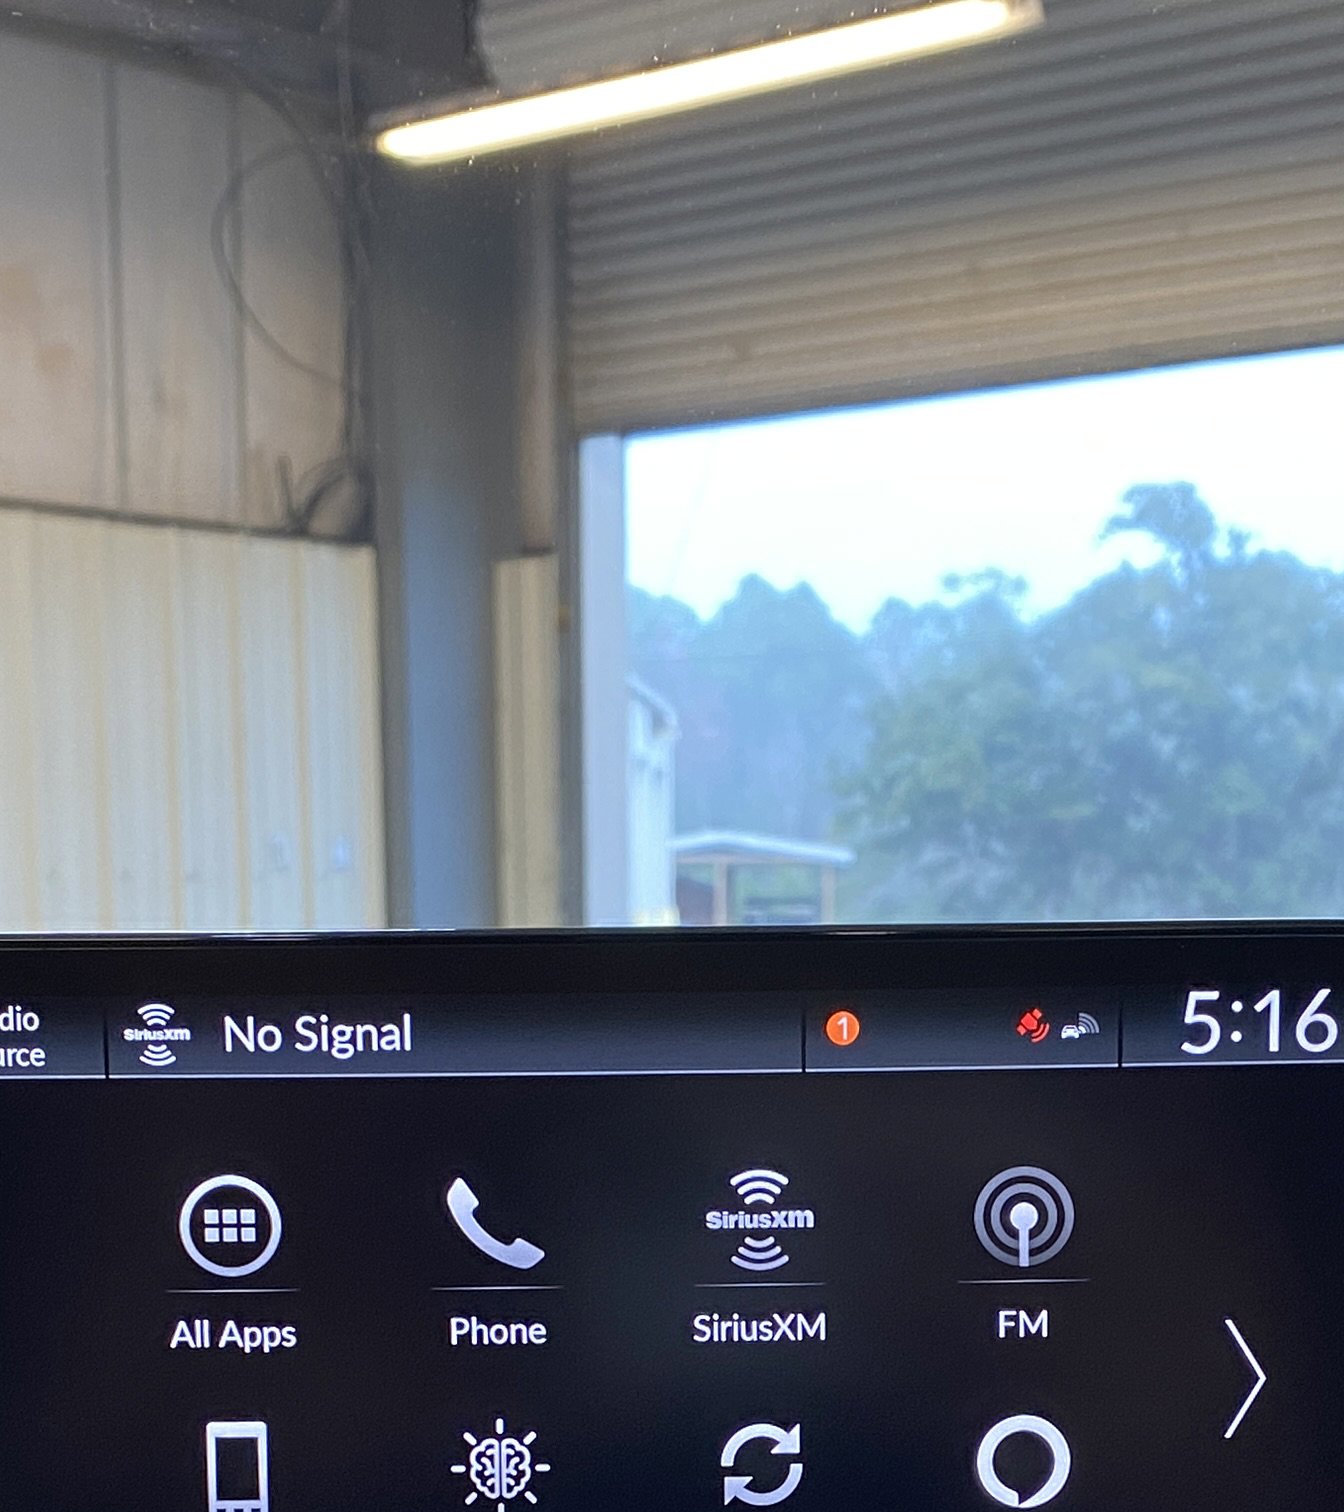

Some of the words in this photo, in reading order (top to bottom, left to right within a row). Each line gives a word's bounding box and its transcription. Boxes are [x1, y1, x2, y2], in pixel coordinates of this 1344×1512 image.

[835, 1016, 850, 1042] 1
[1181, 989, 1338, 1054] 5:16
[224, 1016, 282, 1052] No
[295, 1014, 411, 1059] Signal
[170, 1320, 210, 1348] All
[219, 1320, 296, 1353] Apps
[451, 1316, 547, 1345] Phone
[694, 1313, 825, 1342] SiriusXM
[999, 1310, 1048, 1338] FM
